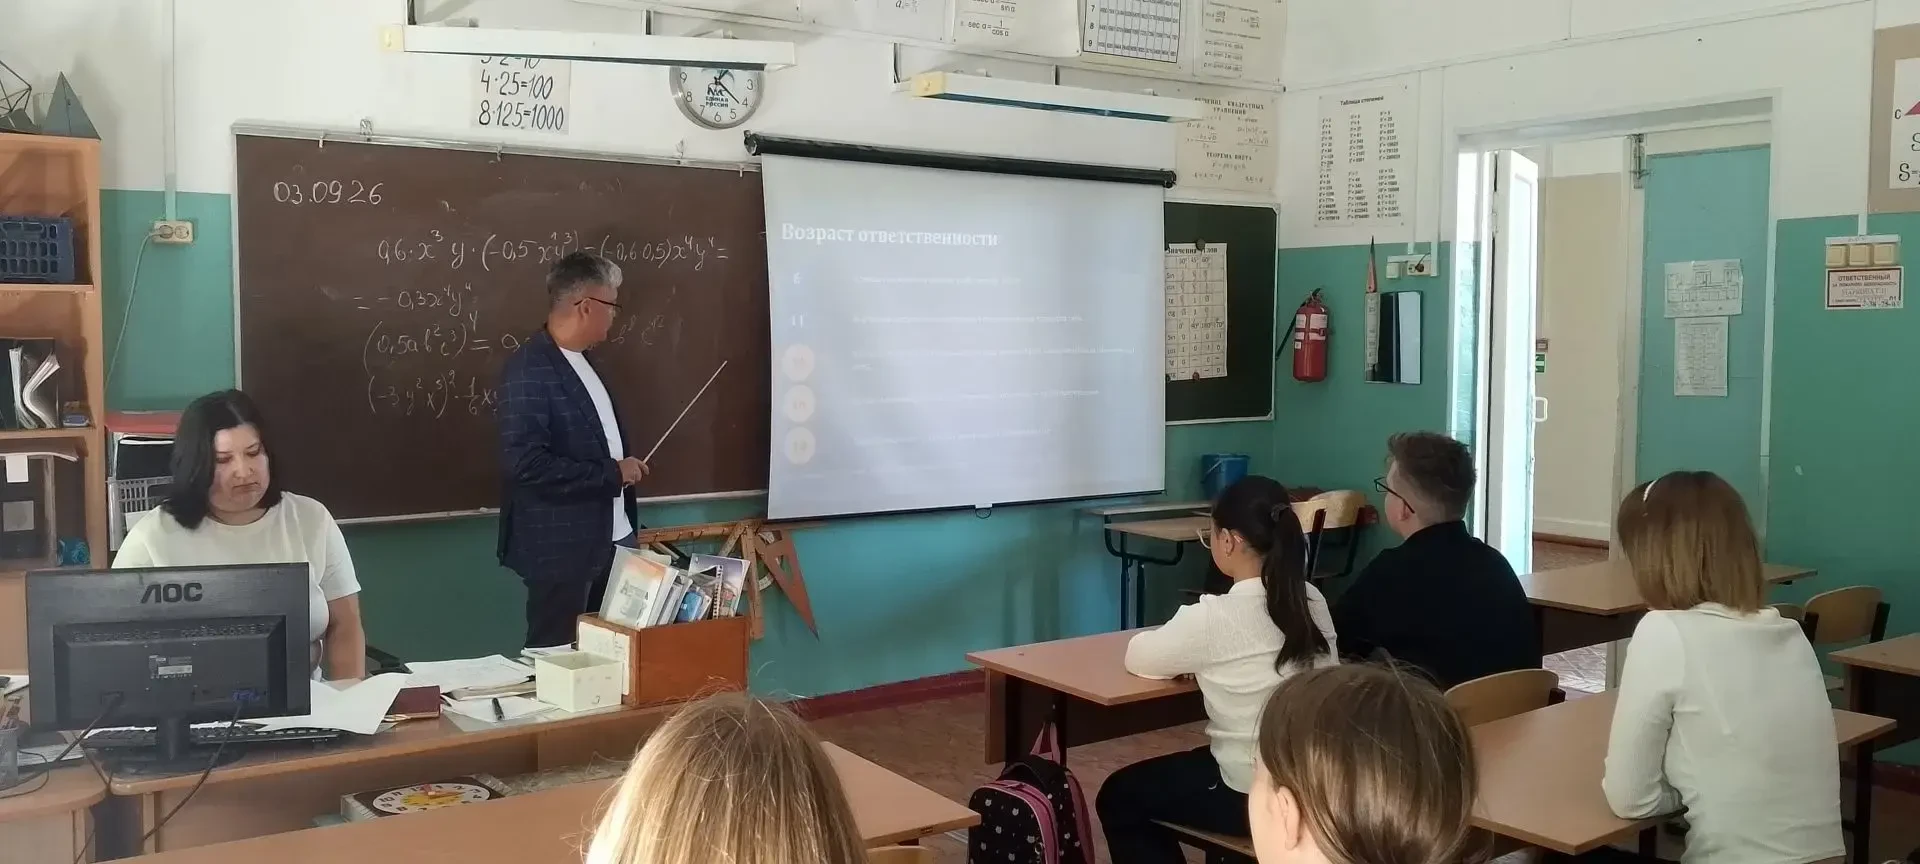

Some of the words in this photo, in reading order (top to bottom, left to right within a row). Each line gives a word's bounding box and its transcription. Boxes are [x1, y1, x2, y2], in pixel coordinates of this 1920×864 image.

[1091, 5, 1096, 13] 7
[1090, 22, 1095, 30] 8
[1088, 39, 1093, 47] 9
[680, 72, 687, 83] 9
[746, 79, 754, 90] 3
[686, 91, 692, 102] 8
[742, 97, 748, 107] 4
[700, 105, 705, 116] 7
[730, 109, 737, 119] 5
[714, 112, 721, 122] 6
[782, 222, 855, 247] Возраст
[858, 228, 1000, 249] ответственности
[1838, 273, 1891, 282] ОТВЕТСТВЕННЫЙ
[140, 582, 203, 604] AOC
